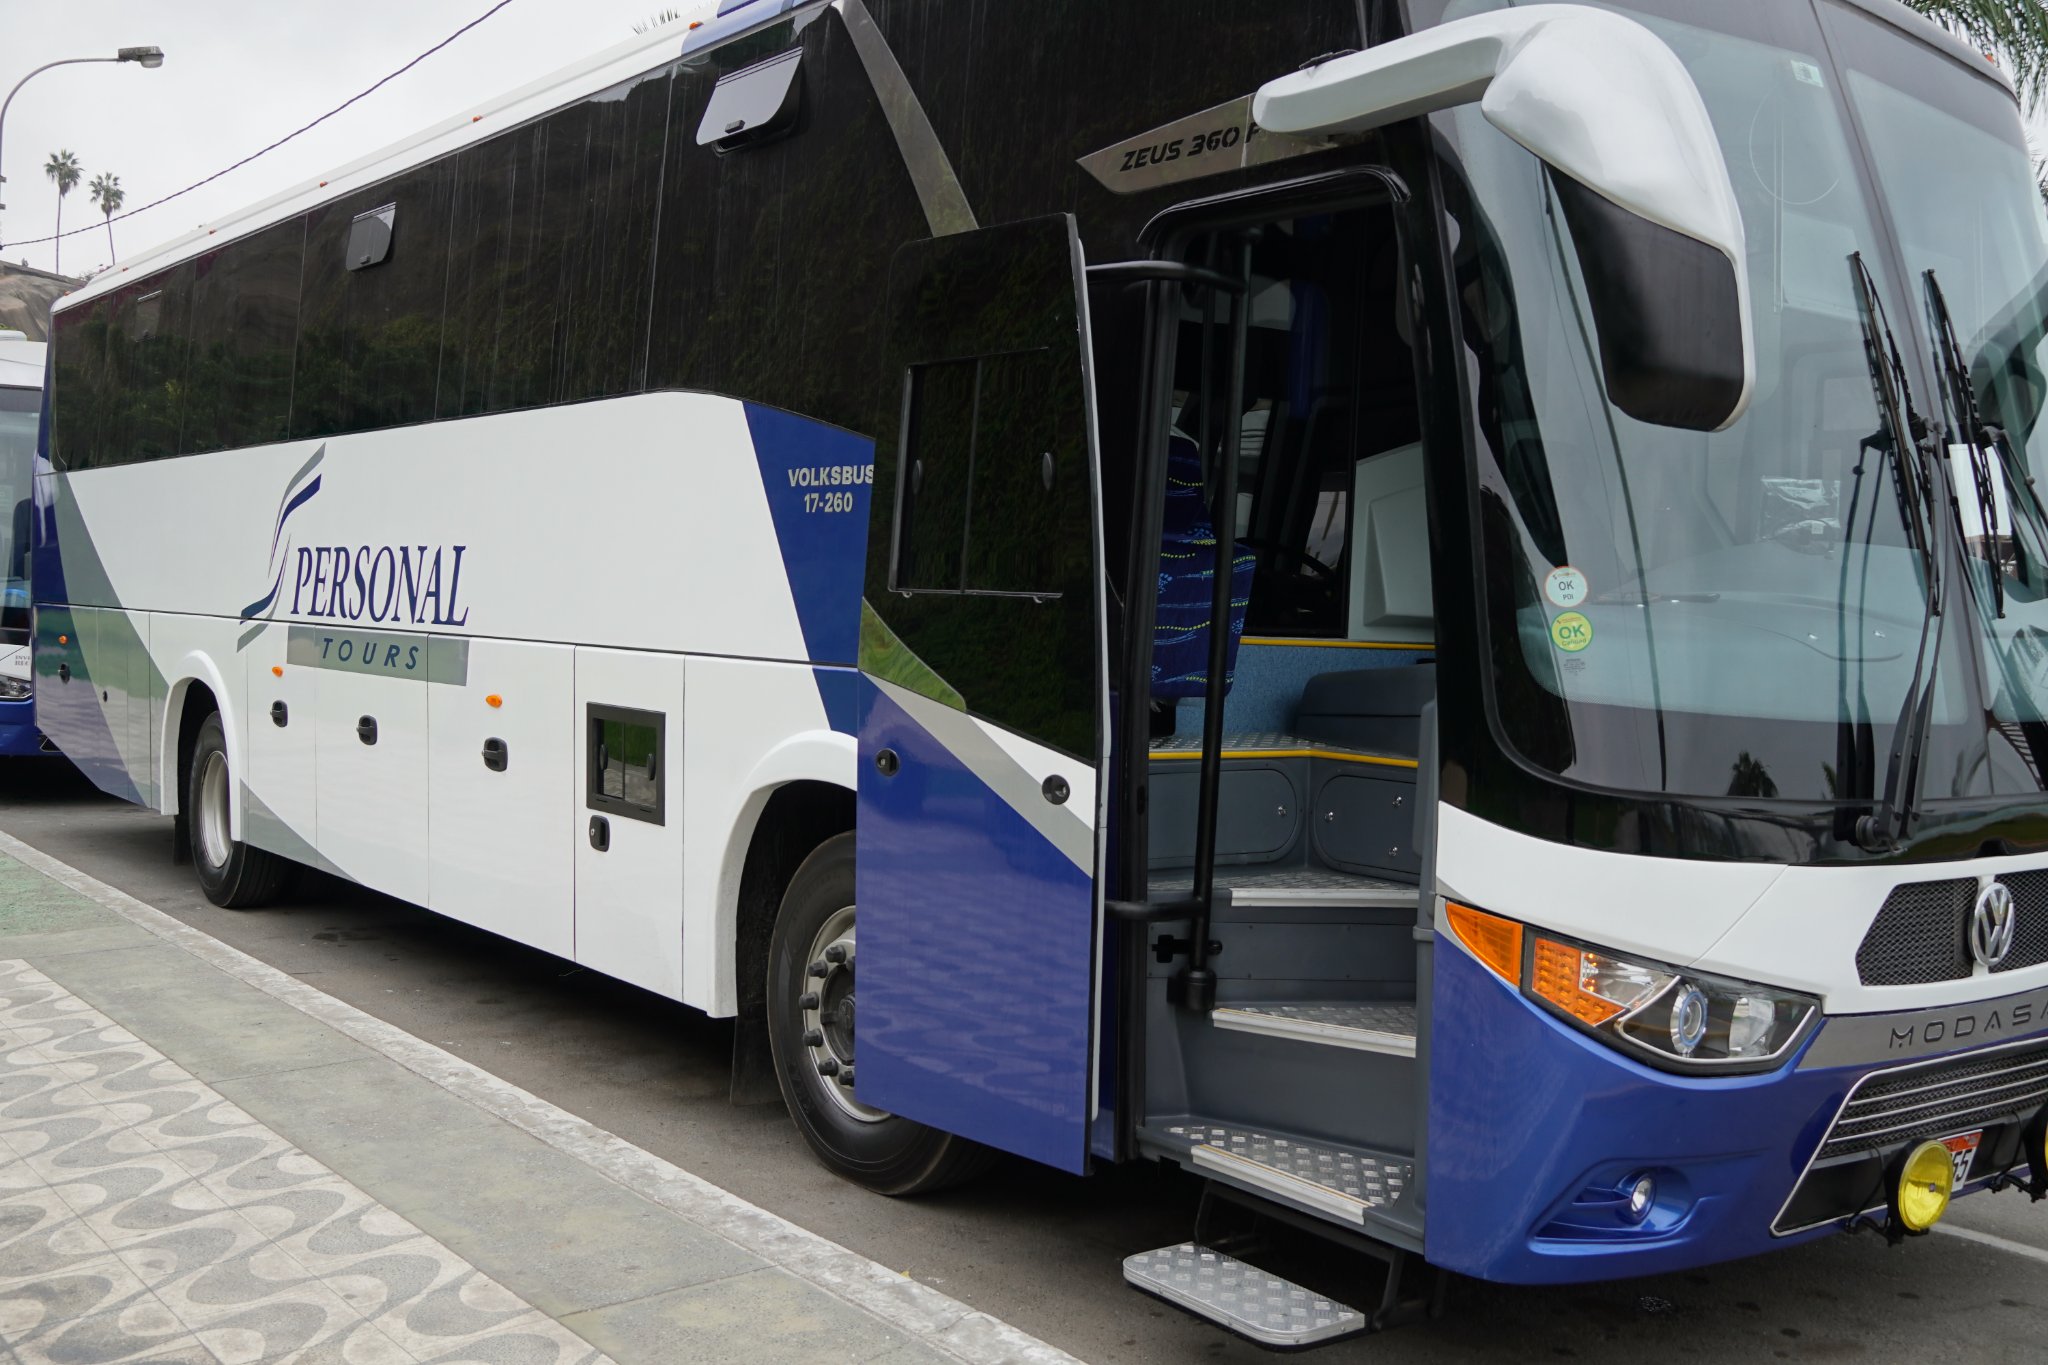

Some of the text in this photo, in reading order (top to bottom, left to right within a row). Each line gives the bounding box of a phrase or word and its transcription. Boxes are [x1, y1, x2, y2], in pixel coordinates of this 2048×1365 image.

[1120, 139, 1183, 172] ZEUS
[1188, 127, 1239, 156] 360
[788, 464, 874, 487] VOLKSBUS
[804, 491, 853, 513] 17-260
[290, 545, 469, 626] PERSONAL
[1558, 580, 1574, 591] OK
[1559, 624, 1585, 639] OK
[322, 637, 419, 670] TOURS
